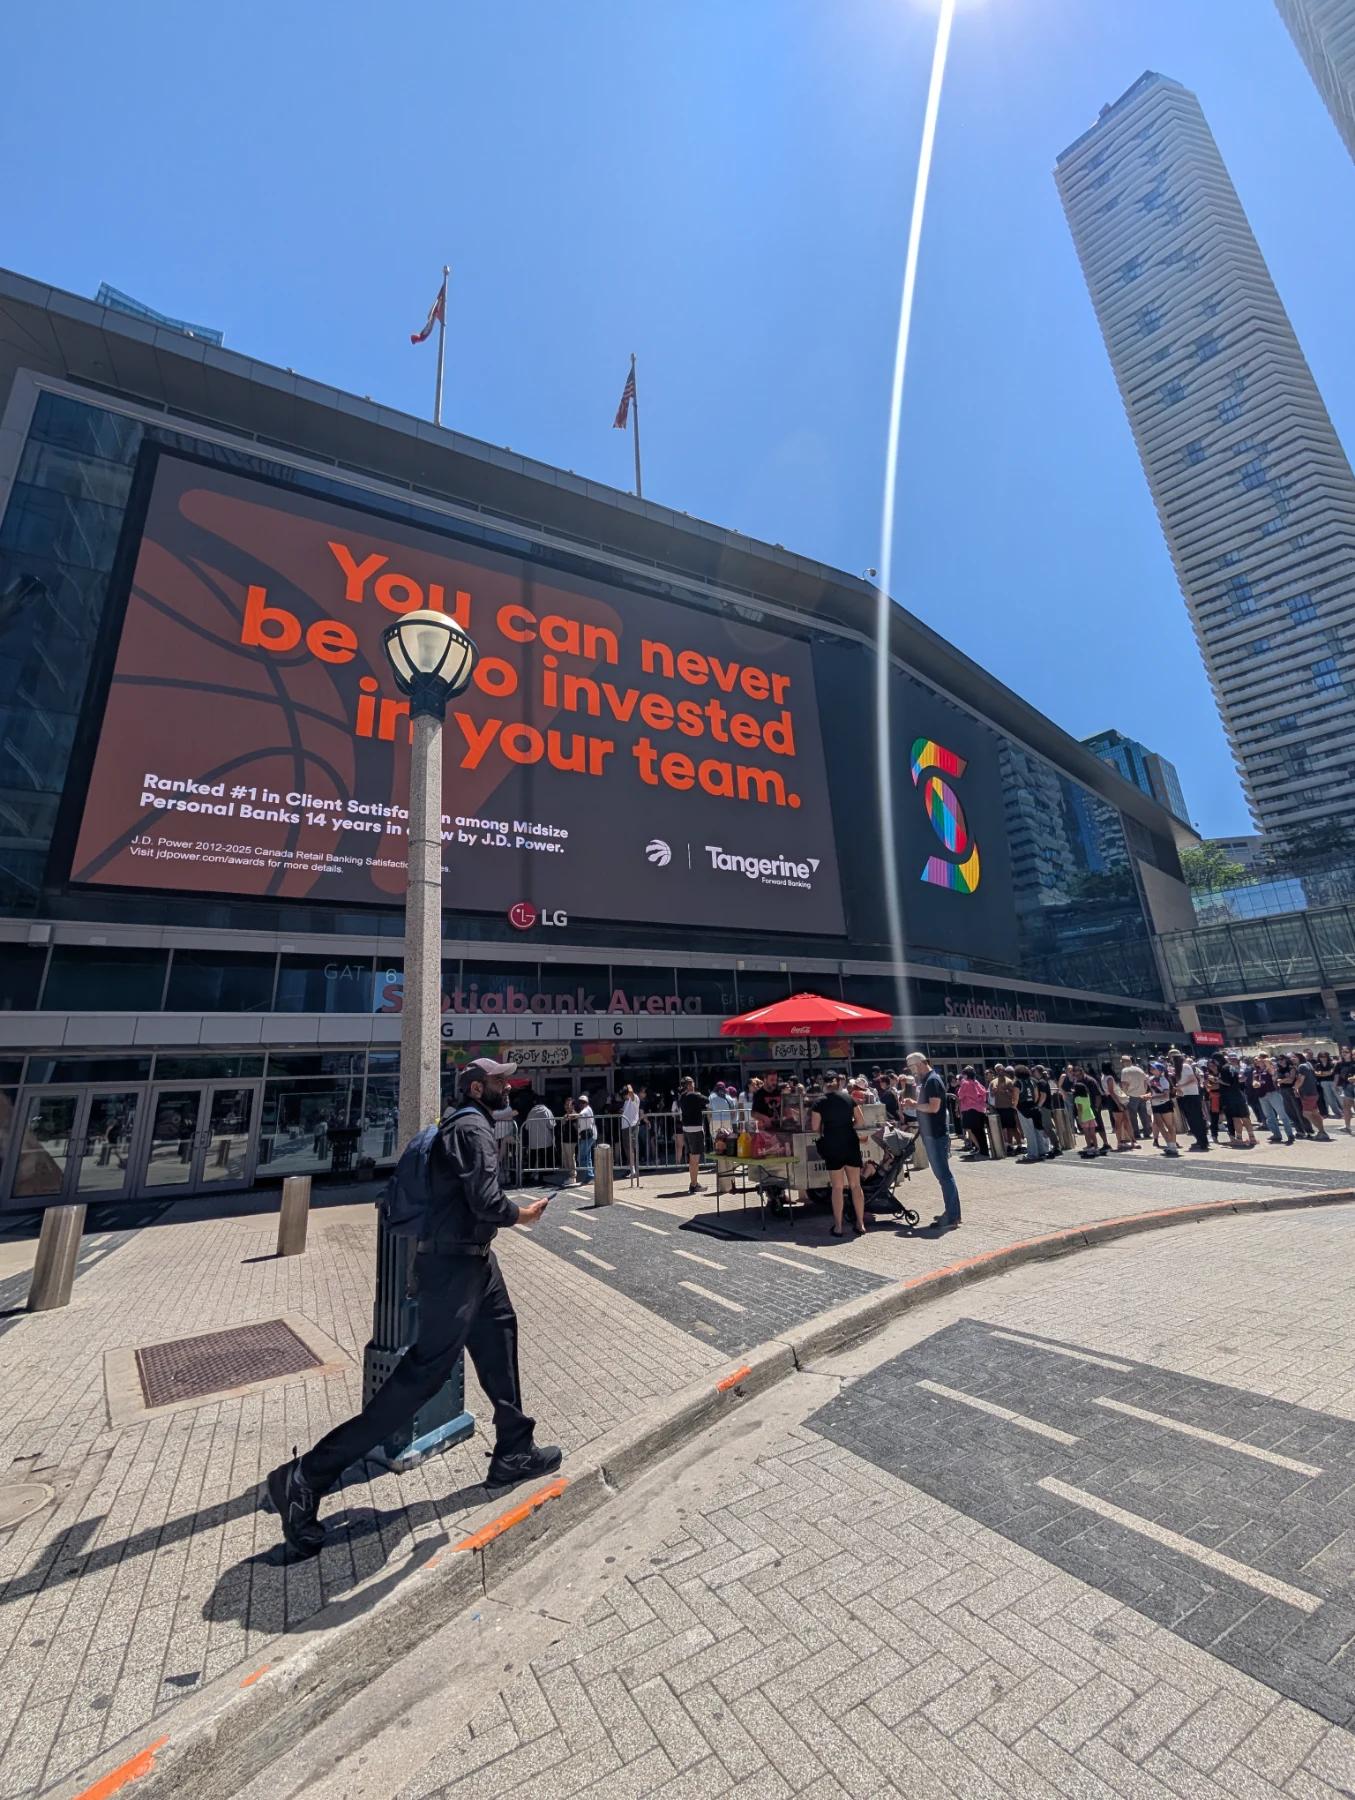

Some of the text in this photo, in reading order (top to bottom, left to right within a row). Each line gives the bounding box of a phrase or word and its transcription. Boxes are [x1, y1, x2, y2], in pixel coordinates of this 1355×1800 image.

[329, 541, 791, 705] You can never
[241, 585, 359, 664] be
[543, 655, 796, 756] invested
[355, 676, 415, 746] in
[453, 711, 615, 776] your
[633, 738, 802, 808] team.
[143, 773, 225, 797] Ranked
[230, 785, 257, 801] #1
[262, 788, 281, 804] in
[285, 792, 343, 812] Client
[347, 799, 451, 825] Satisfan
[455, 816, 509, 834] among
[513, 820, 569, 839] Midsize
[140, 792, 235, 817] Personal
[240, 804, 300, 824] Banks
[305, 812, 327, 827] 14
[332, 818, 382, 833] years
[386, 821, 402, 835] in
[458, 830, 478, 846] by
[481, 833, 512, 848] J.D.
[515, 836, 565, 853] Power.
[130, 846, 154, 857] Visit
[155, 849, 265, 867] jdpower.com/awards
[267, 858, 281, 868] for
[283, 862, 309, 870] more
[131, 835, 153, 845] J.D.
[157, 837, 193, 849] Power
[195, 841, 252, 854] 2012-2025
[254, 847, 294, 859] Canada
[296, 850, 324, 861] Retail
[326, 854, 363, 866] Banking
[705, 845, 810, 879] Tangerine
[761, 877, 811, 889] Forward Banking
[541, 908, 568, 927] LG
[385, 968, 397, 984] 6
[381, 983, 702, 1015] Stiabank Arena
[944, 997, 1047, 1023] Scotiabank Arena
[440, 1022, 624, 1038] GATE 6
